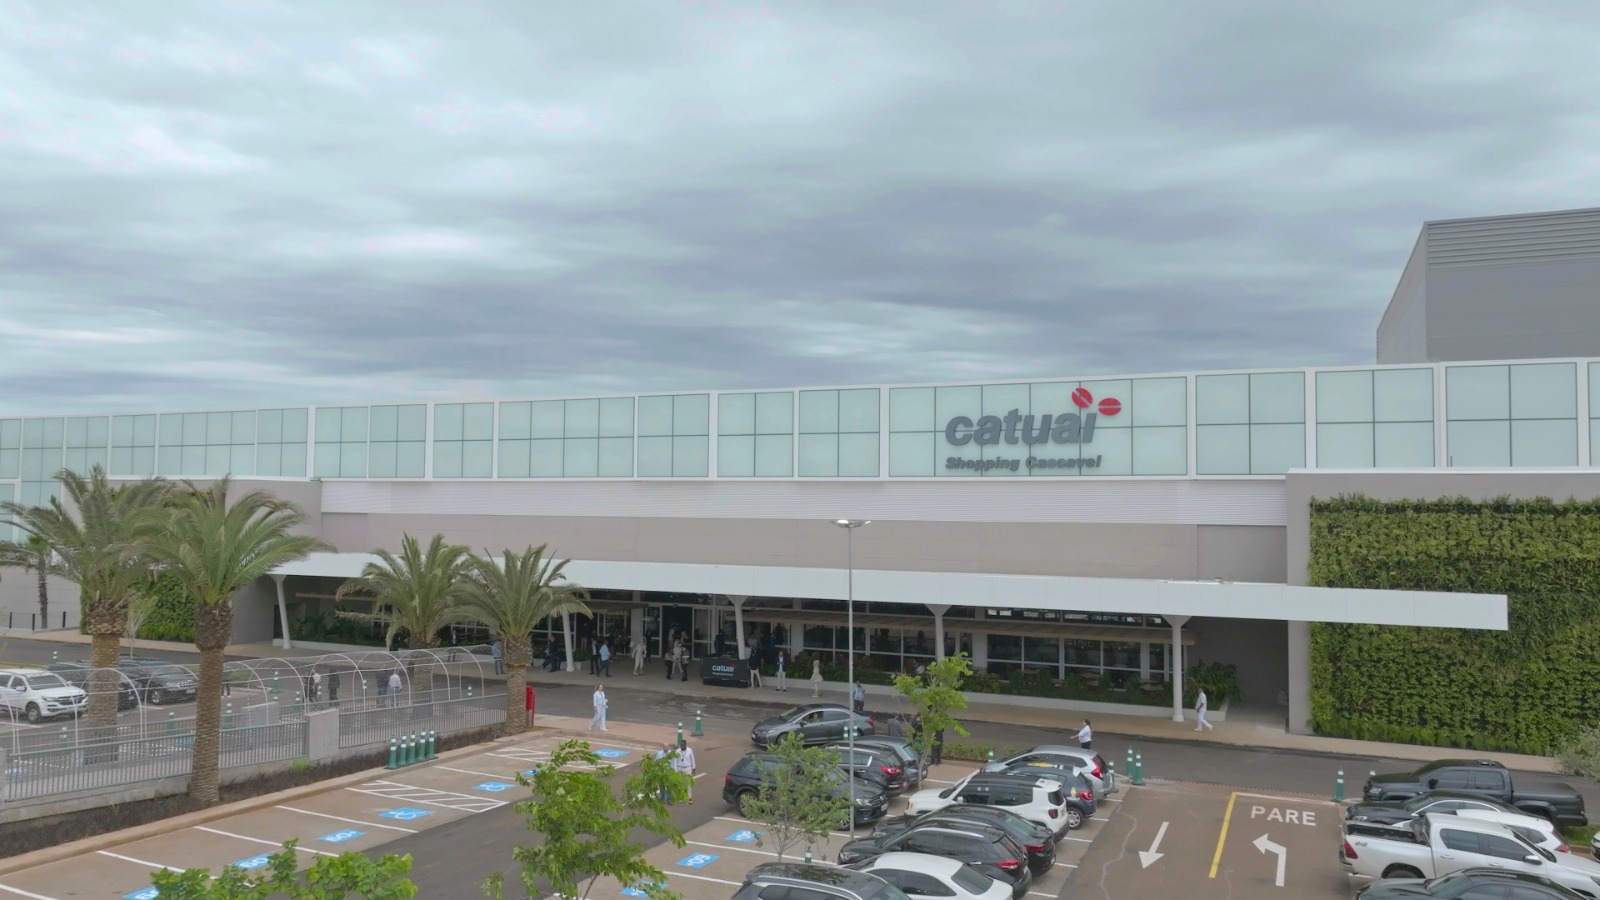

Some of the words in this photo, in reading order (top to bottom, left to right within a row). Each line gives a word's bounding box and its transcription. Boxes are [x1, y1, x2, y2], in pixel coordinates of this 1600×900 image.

[945, 456, 1020, 471] Shopping
[1026, 455, 1102, 469] Cascavel
[1250, 805, 1317, 826] PARE
